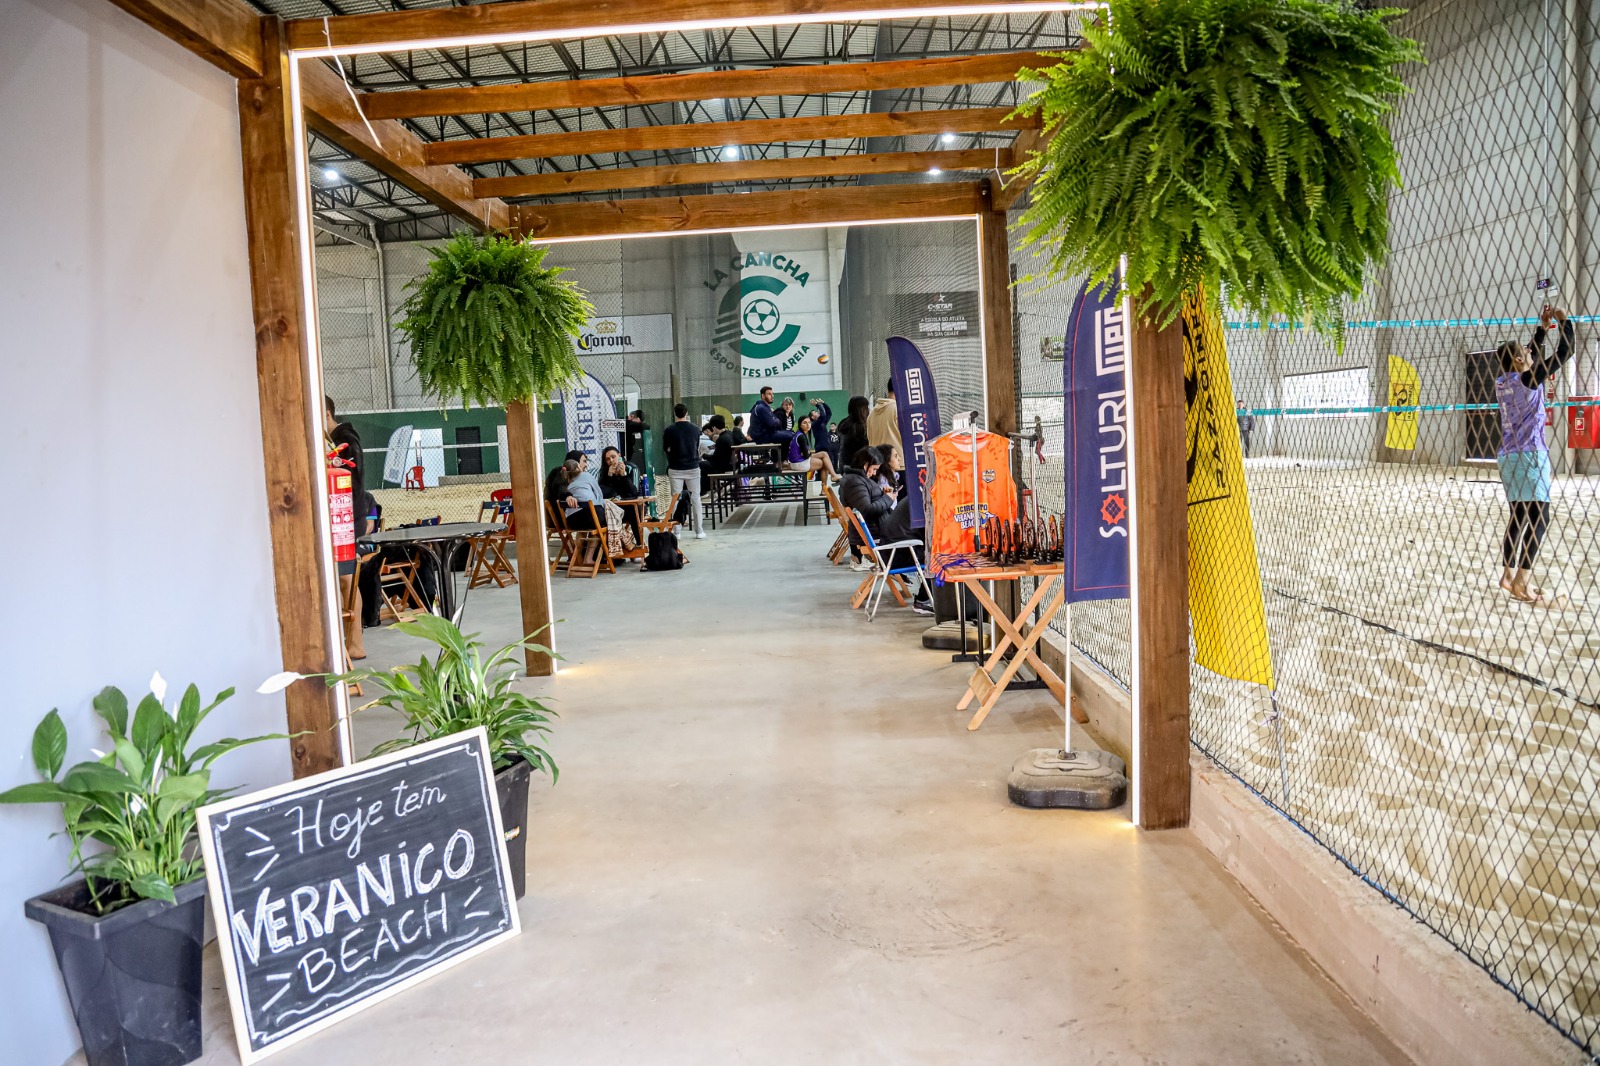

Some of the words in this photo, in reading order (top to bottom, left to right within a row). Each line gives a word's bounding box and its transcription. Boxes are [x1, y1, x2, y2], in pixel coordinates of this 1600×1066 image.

[703, 268, 729, 292] LA
[730, 251, 810, 288] CANCHA
[577, 333, 632, 352] Corona
[710, 347, 761, 378] ESPORTES
[765, 366, 778, 377] DE
[782, 344, 810, 371] AREIA
[285, 797, 384, 858] Hoje
[391, 779, 447, 817] tem
[297, 892, 448, 994] BEACH
